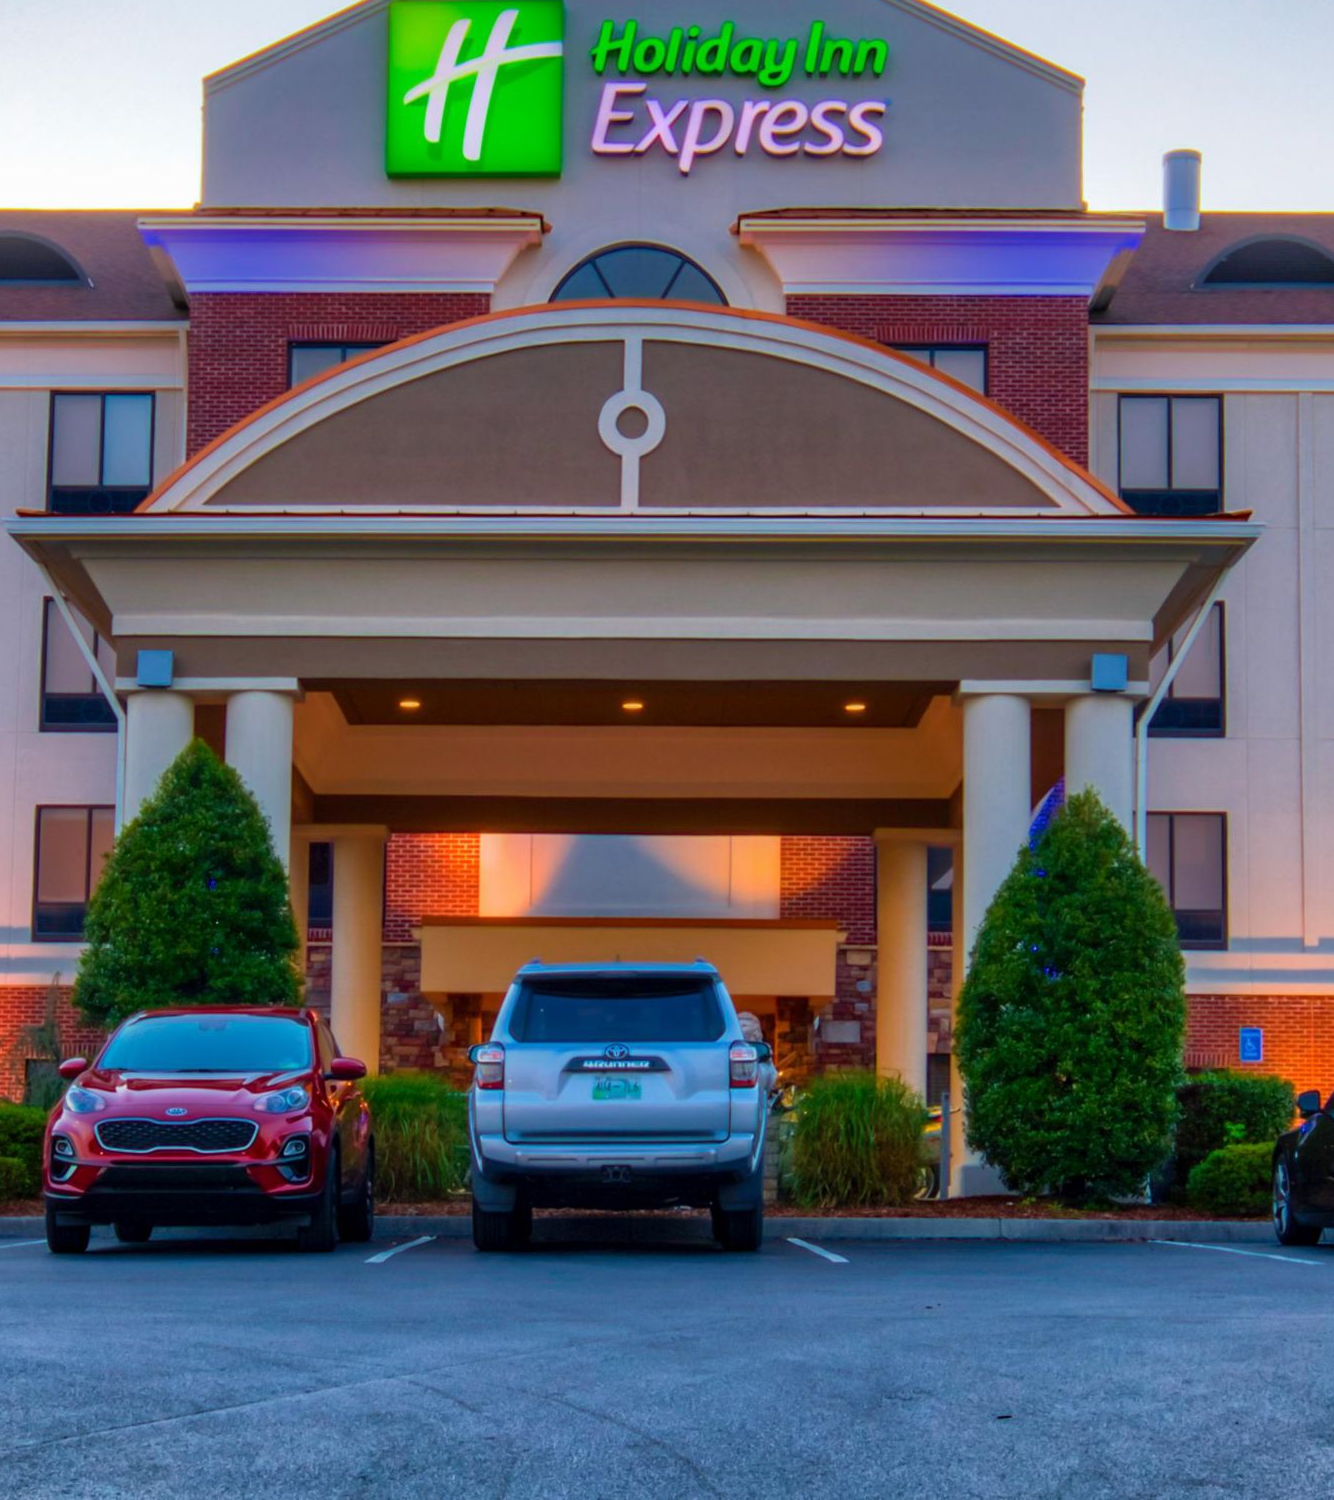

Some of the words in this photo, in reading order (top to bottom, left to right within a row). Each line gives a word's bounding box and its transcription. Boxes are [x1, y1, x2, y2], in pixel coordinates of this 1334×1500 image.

[589, 18, 799, 88] Holiday
[804, 19, 889, 77] Inn
[590, 82, 887, 177] Express
